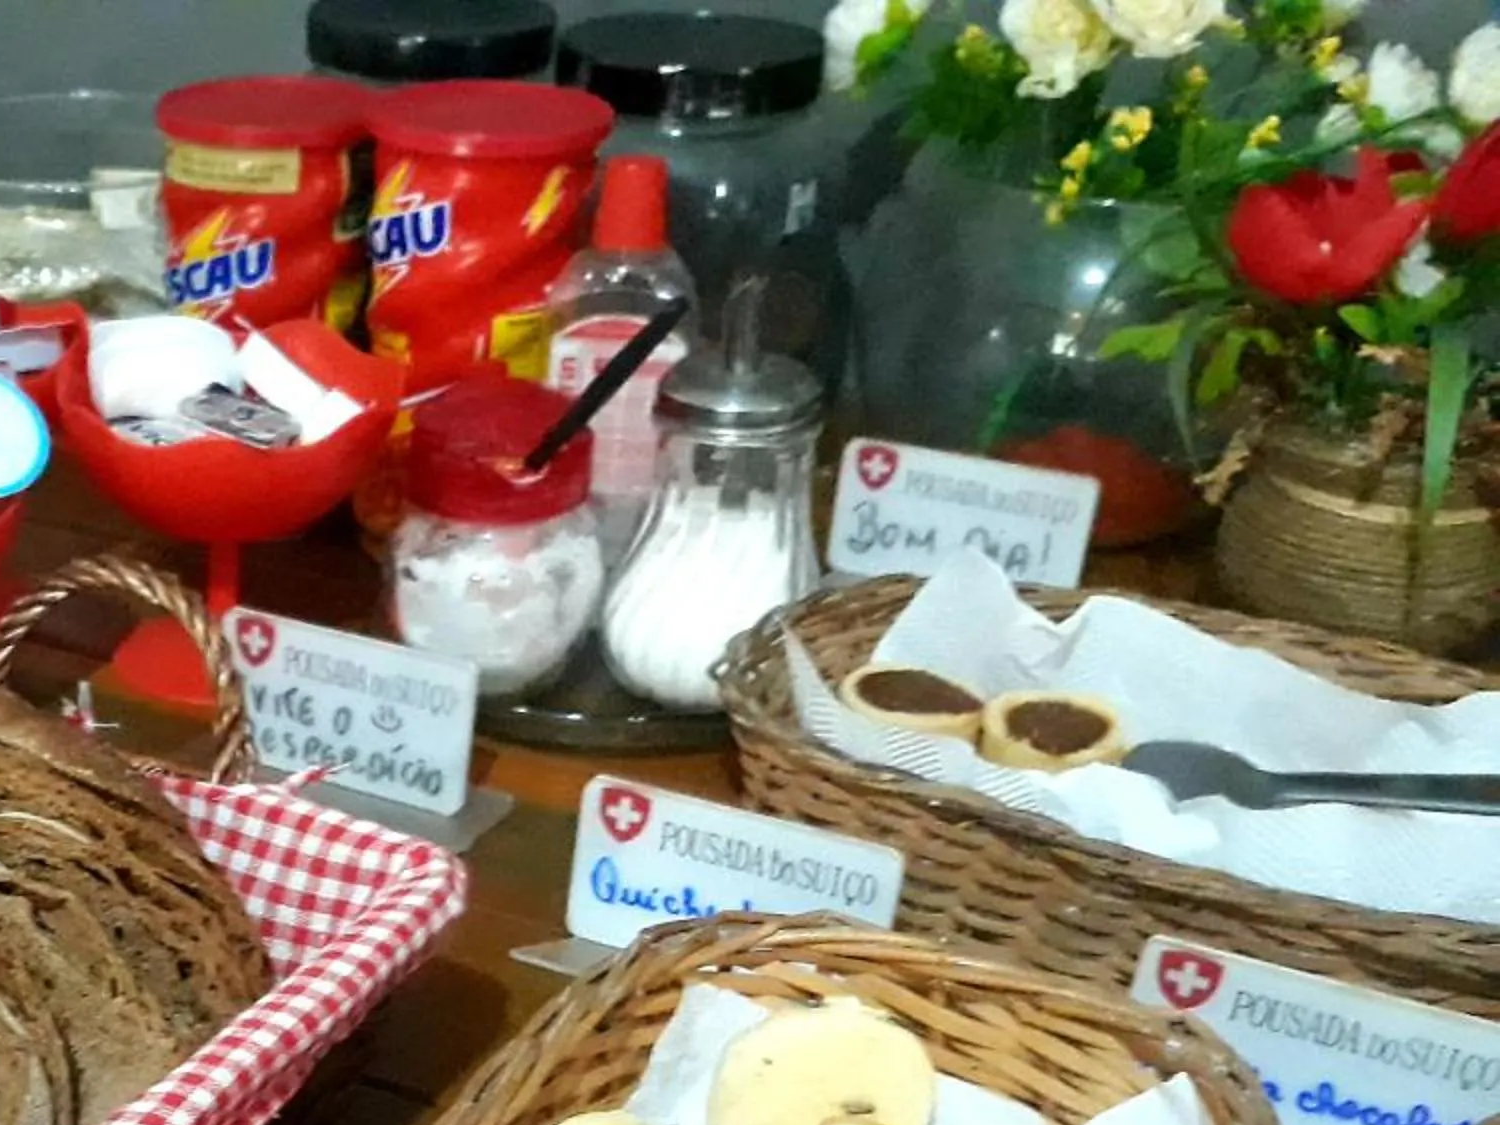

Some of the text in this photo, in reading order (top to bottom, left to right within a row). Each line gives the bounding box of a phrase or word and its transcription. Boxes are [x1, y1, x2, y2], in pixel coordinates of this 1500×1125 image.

[659, 821, 766, 882] POUSADA
[799, 860, 879, 908] SUIÇO
[1229, 990, 1361, 1055] POUSADA
[1400, 1036, 1500, 1093] SUIÇO
